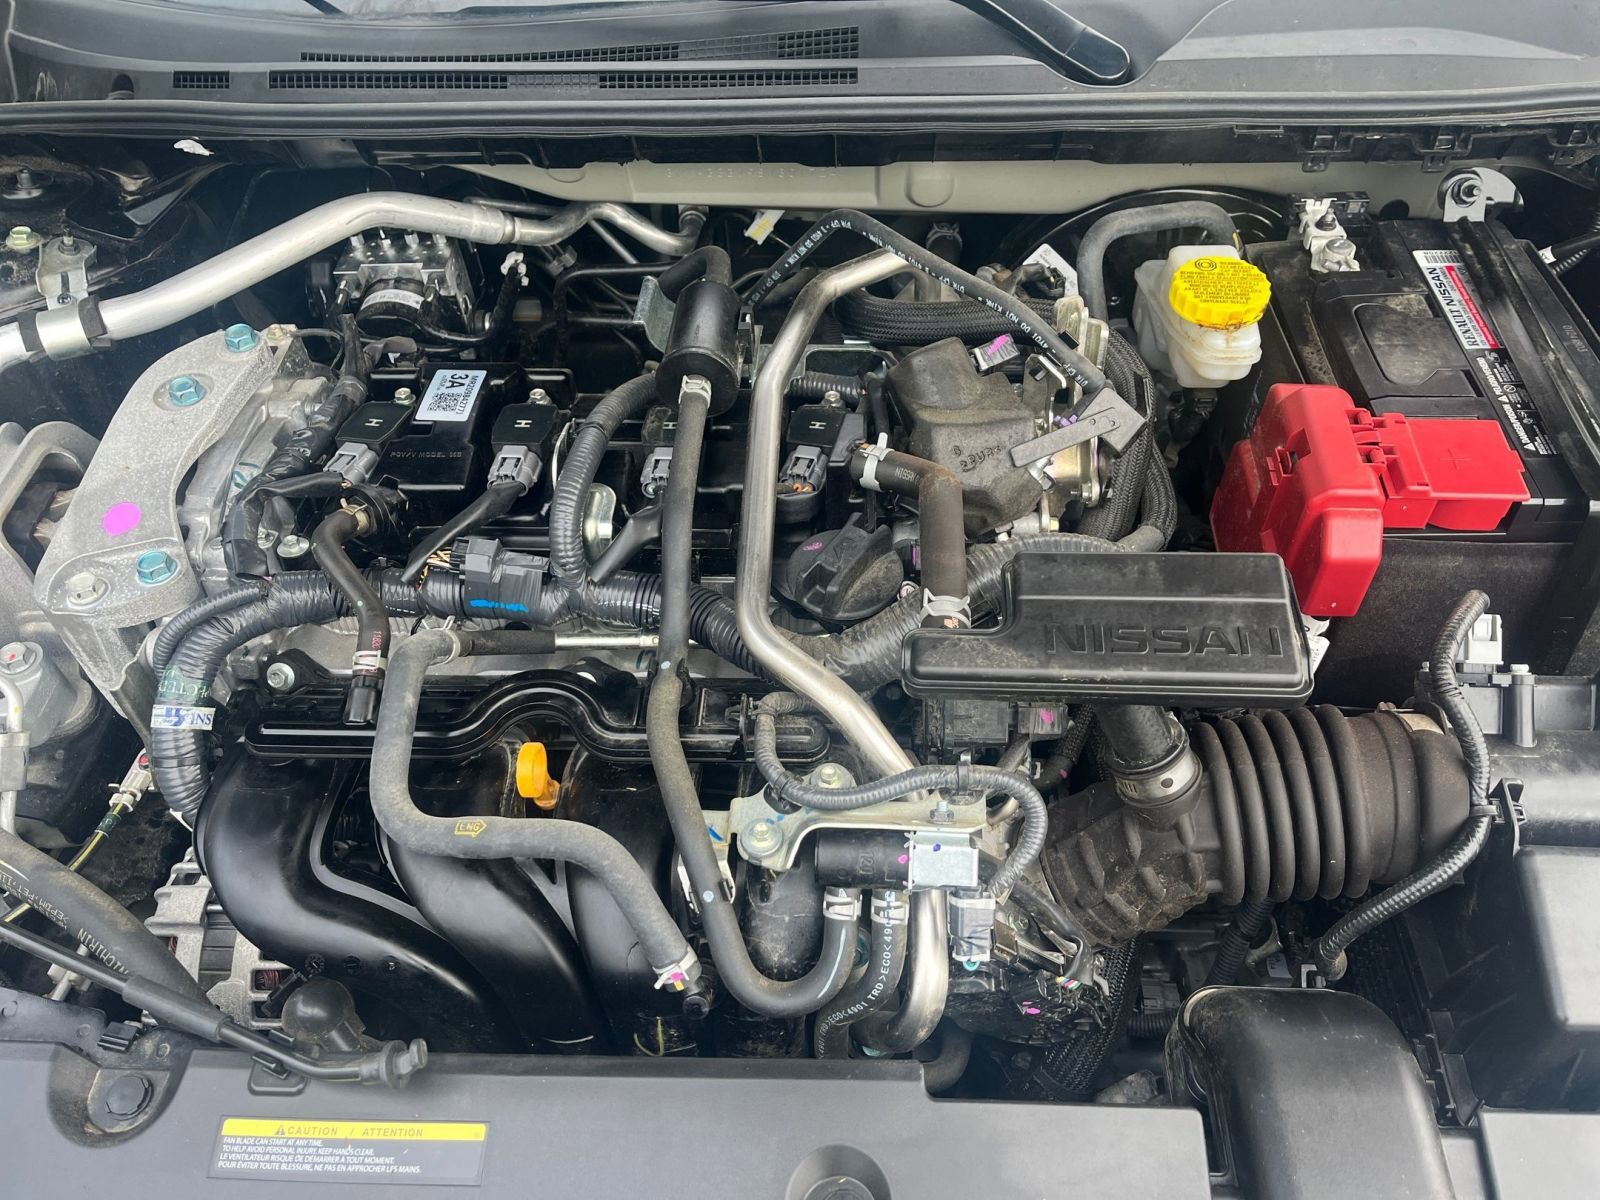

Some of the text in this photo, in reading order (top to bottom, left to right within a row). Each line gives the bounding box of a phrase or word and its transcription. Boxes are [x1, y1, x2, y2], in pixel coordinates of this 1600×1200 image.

[1426, 267, 1458, 306] NISSAN
[1449, 308, 1480, 346] RENAULT
[445, 373, 470, 389] 3A
[1046, 623, 1285, 658] NISSAN
[459, 822, 481, 831] ENG
[288, 1125, 339, 1136] CAUTION
[362, 1127, 424, 1138] ATTENTION
[223, 1136, 236, 1145] FAN
[236, 1137, 255, 1146] BLADE
[255, 1137, 269, 1146] CAN
